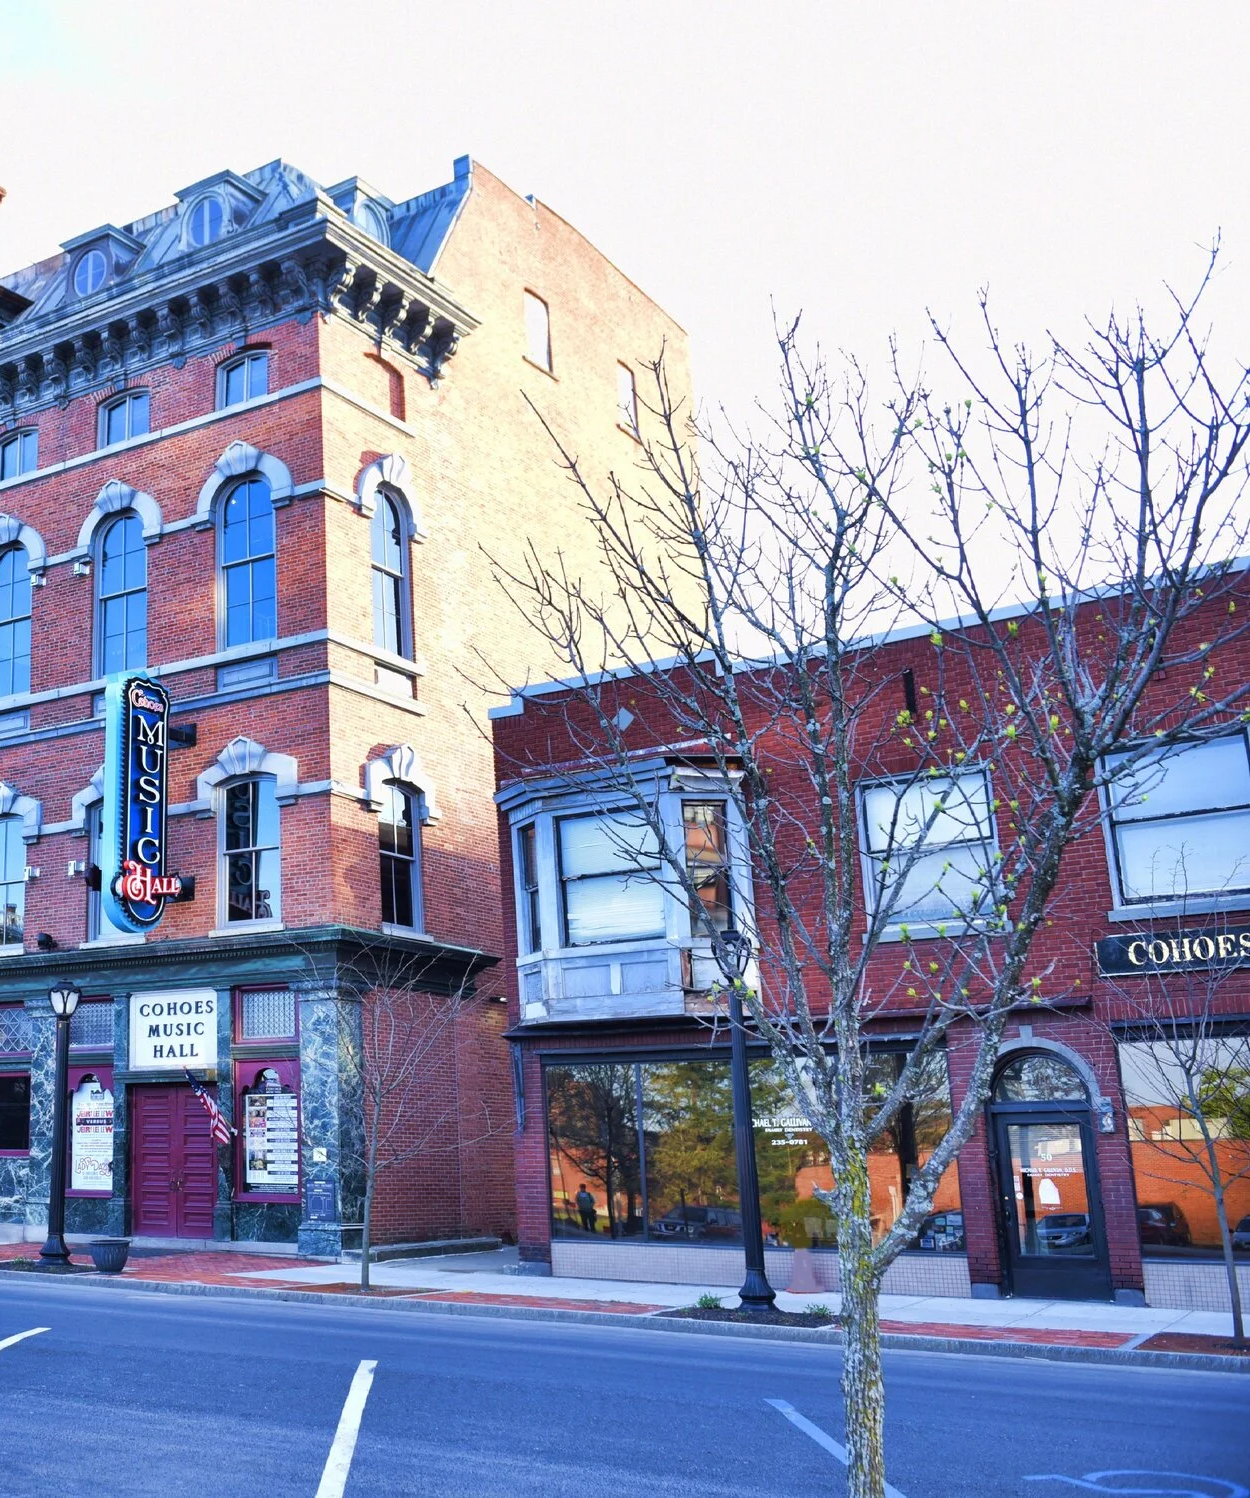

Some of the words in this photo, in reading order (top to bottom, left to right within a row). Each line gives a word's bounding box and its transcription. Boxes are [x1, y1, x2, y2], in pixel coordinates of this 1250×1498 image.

[136, 714, 165, 865] MUSIC
[1128, 933, 1250, 966] COHOES
[139, 1000, 214, 1017] COHOES
[147, 1022, 205, 1038] MUSIC
[153, 1043, 199, 1058] HALL
[1041, 1153, 1053, 1162] 50
